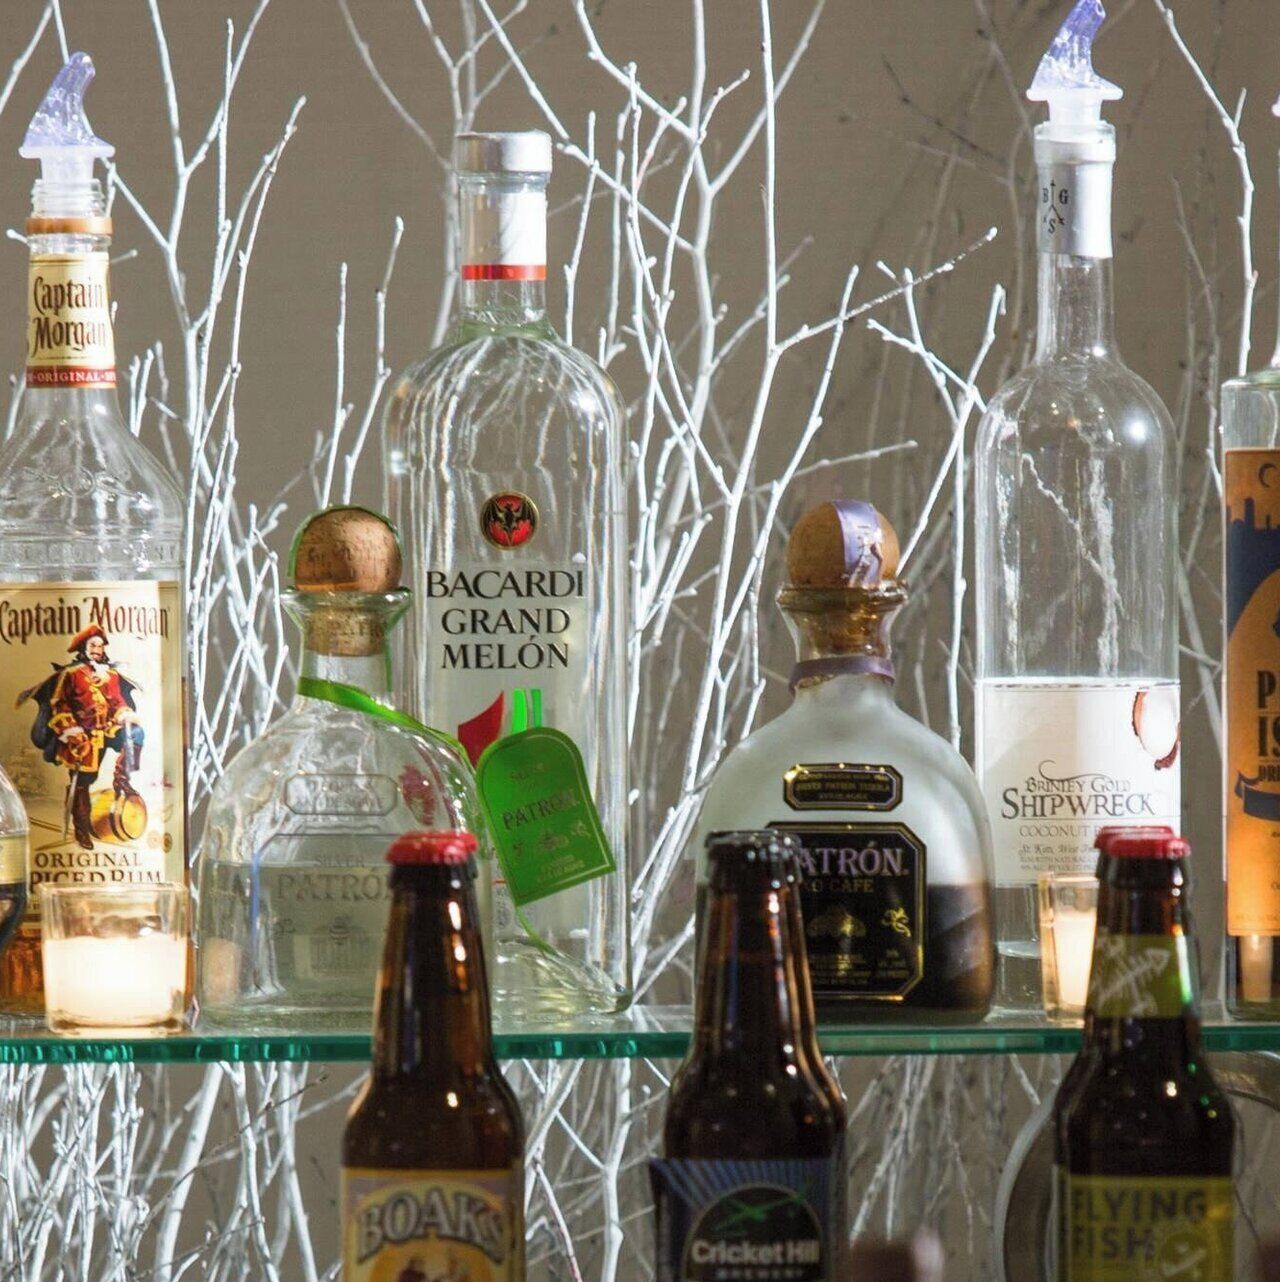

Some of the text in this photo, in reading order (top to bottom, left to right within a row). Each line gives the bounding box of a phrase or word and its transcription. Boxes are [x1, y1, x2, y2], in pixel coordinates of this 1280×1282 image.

[34, 276, 103, 316] Captain
[32, 317, 106, 358] Morgan
[37, 372, 99, 382] ORIGINAL
[426, 570, 583, 599] BACARDI
[83, 596, 169, 640] Morgan
[441, 608, 570, 635] GRAND
[442, 635, 568, 669] MELÓN
[1002, 788, 1155, 819] SHIPWRECK
[1020, 825, 1090, 837] COCONUT
[35, 852, 142, 867] ORIGINAL
[799, 841, 903, 876] ATRÓN
[277, 866, 393, 901] PATRÓ
[1072, 1188, 1206, 1222] FLYING
[356, 1186, 504, 1264] BOAKS
[692, 1239, 819, 1264] Cricket Hill
[1072, 1225, 1155, 1260] FISH
